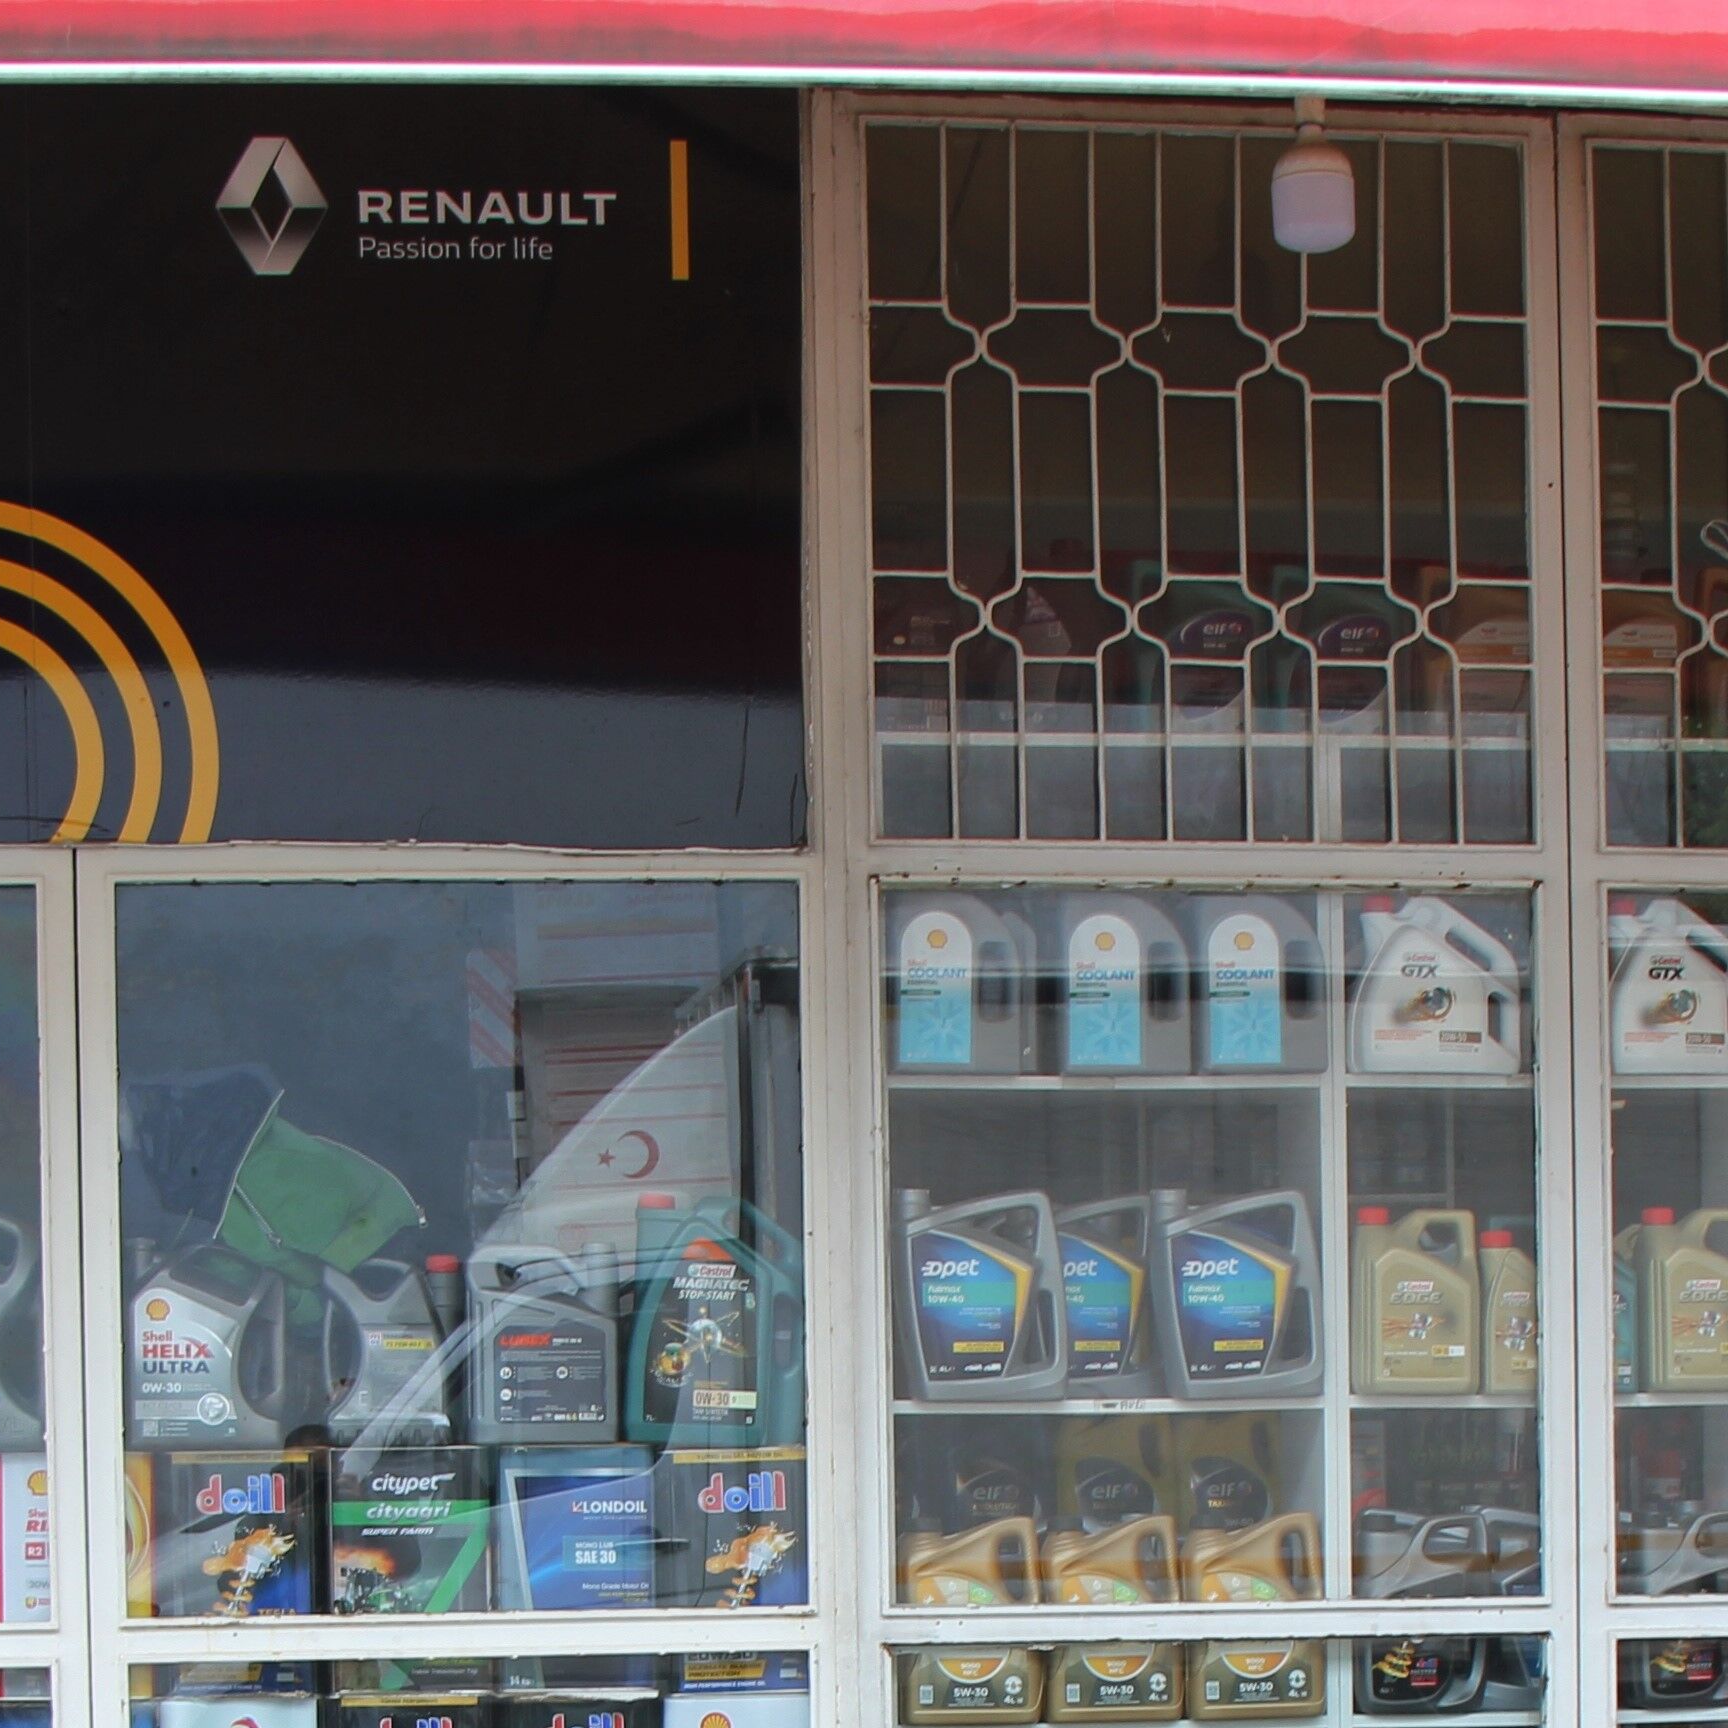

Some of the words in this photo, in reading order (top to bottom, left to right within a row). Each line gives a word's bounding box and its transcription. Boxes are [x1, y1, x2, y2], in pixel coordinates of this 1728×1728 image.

[358, 190, 617, 226] RENAULT
[358, 236, 461, 260] Passion
[469, 236, 507, 260] for
[512, 236, 554, 260] life
[907, 968, 967, 981] COOLANT
[1076, 968, 1135, 982] COOLANT
[1215, 968, 1275, 981] COOLANT
[1401, 964, 1438, 978] GTX
[1648, 966, 1685, 981] GTX
[700, 1265, 733, 1277] Castrol
[672, 1276, 750, 1292] MAGNATEC
[678, 1289, 737, 1301] STOP-START
[1390, 1292, 1443, 1305] EDGE
[142, 1330, 173, 1342] Shell
[142, 1341, 215, 1359] HELIX
[142, 1360, 211, 1375] ULTRA
[371, 1472, 456, 1496] citypet
[196, 1472, 286, 1515] doill
[697, 1471, 787, 1514] doill
[366, 1501, 452, 1521] cityagri
[582, 1500, 648, 1514] LONDOIL
[575, 1550, 598, 1565] SAE
[599, 1549, 616, 1564] 30
[953, 1686, 989, 1698] 5W-30
[1099, 1684, 1135, 1695] 5W-30
[1239, 1681, 1274, 1693] 5W-30
